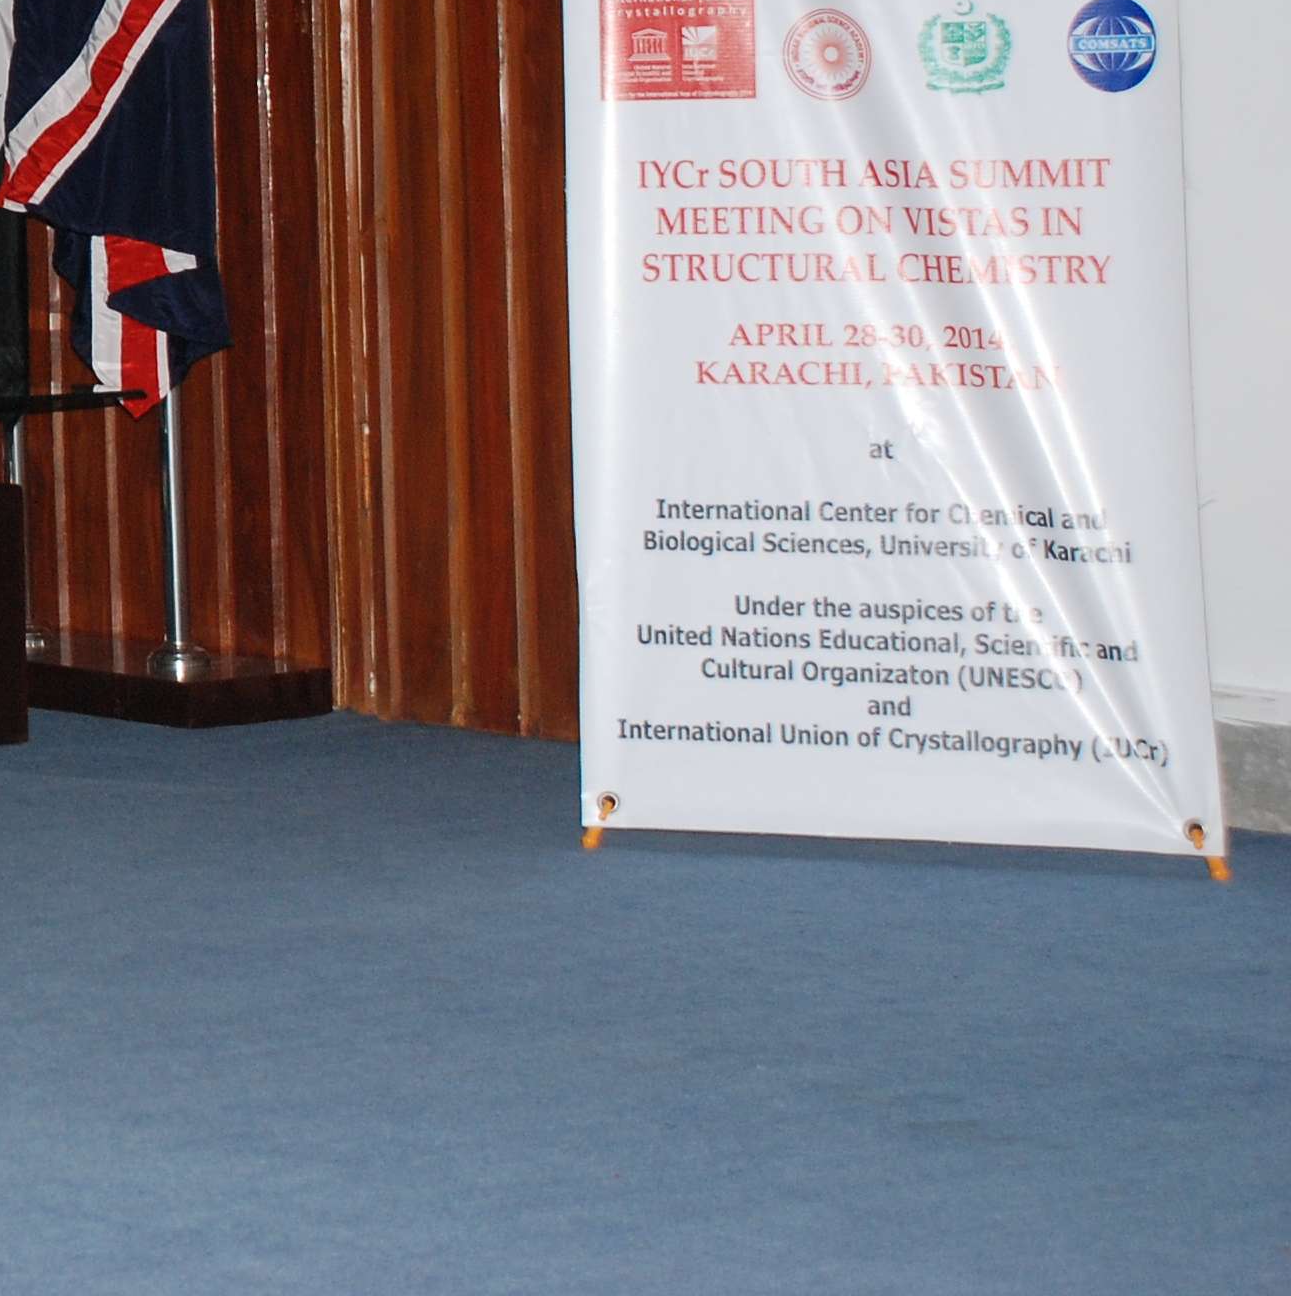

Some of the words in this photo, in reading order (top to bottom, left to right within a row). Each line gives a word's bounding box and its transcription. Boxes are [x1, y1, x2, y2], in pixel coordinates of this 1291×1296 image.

[1078, 38, 1147, 50] COMSATS
[638, 160, 709, 189] IYCr
[719, 159, 846, 189] SOUTH
[858, 160, 938, 189] ASIA
[950, 158, 1111, 189] SUMMIT
[656, 206, 824, 235] MEETING
[837, 206, 892, 235] ON
[902, 207, 1029, 237] VISTAS
[1042, 207, 1083, 236] IN
[643, 253, 886, 282] STRUCTURAL
[729, 323, 833, 347] APRIL
[843, 324, 932, 351] 28-30,
[694, 361, 872, 389] KARACHI,
[869, 440, 895, 460] at
[656, 499, 810, 521] International
[819, 501, 897, 523] Center
[906, 502, 939, 523] for
[644, 530, 755, 555] Biological
[763, 532, 872, 558] Sciences,
[1043, 540, 1131, 564] Karachi
[735, 595, 805, 616] Under
[813, 597, 851, 618] the
[859, 599, 963, 623] auspices
[971, 602, 996, 622] of
[637, 624, 712, 646] United
[721, 626, 811, 649] Nations
[819, 629, 966, 657] Educational,
[1097, 640, 1138, 662] and
[701, 658, 793, 680] Cultural
[802, 661, 949, 687] Organizaton
[868, 696, 912, 716] and
[617, 718, 771, 743] International
[780, 724, 849, 746] Union
[858, 726, 880, 747] of
[889, 728, 1082, 760] Crystallography
